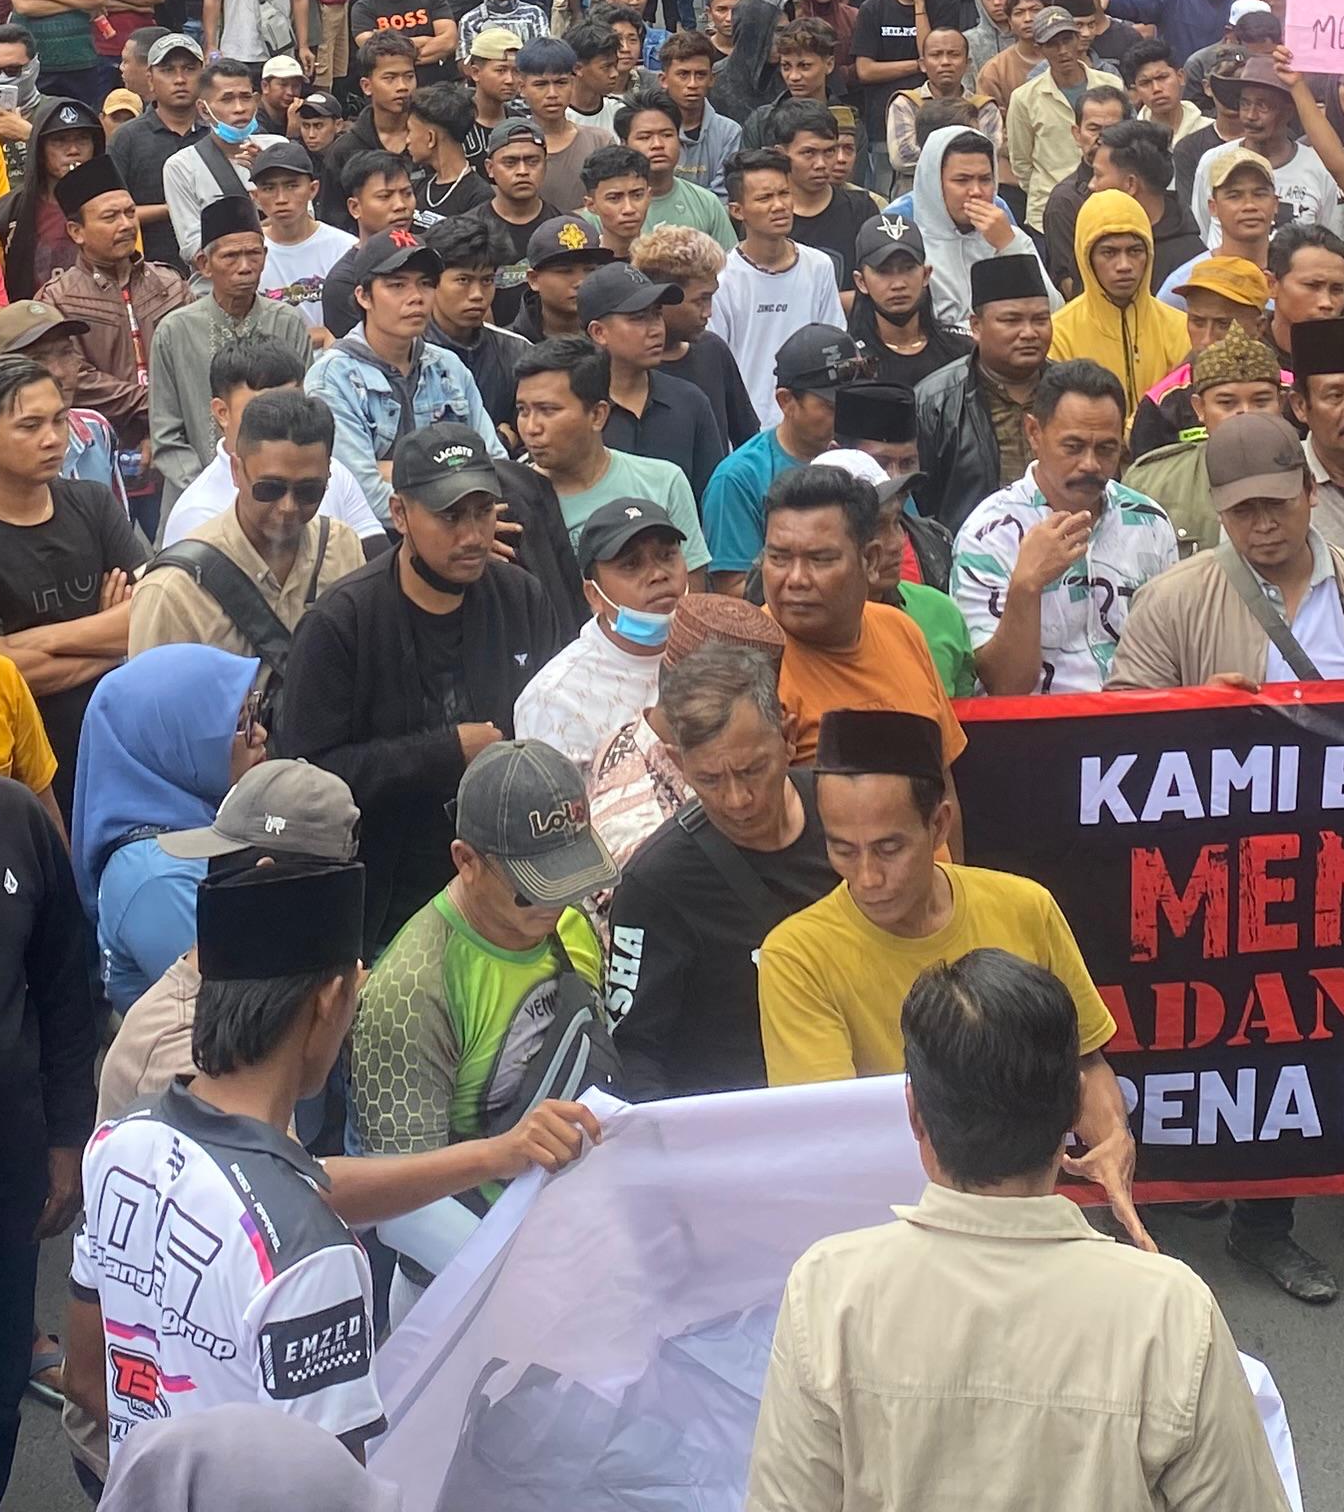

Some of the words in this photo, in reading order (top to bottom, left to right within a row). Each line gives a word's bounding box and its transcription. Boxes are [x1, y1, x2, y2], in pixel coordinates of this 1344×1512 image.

[376, 8, 429, 30] BOSS
[433, 445, 474, 464] LACOSTE
[1078, 744, 1301, 825] KAMI
[161, 1307, 237, 1361] grup
[284, 1314, 362, 1364] EMZED
